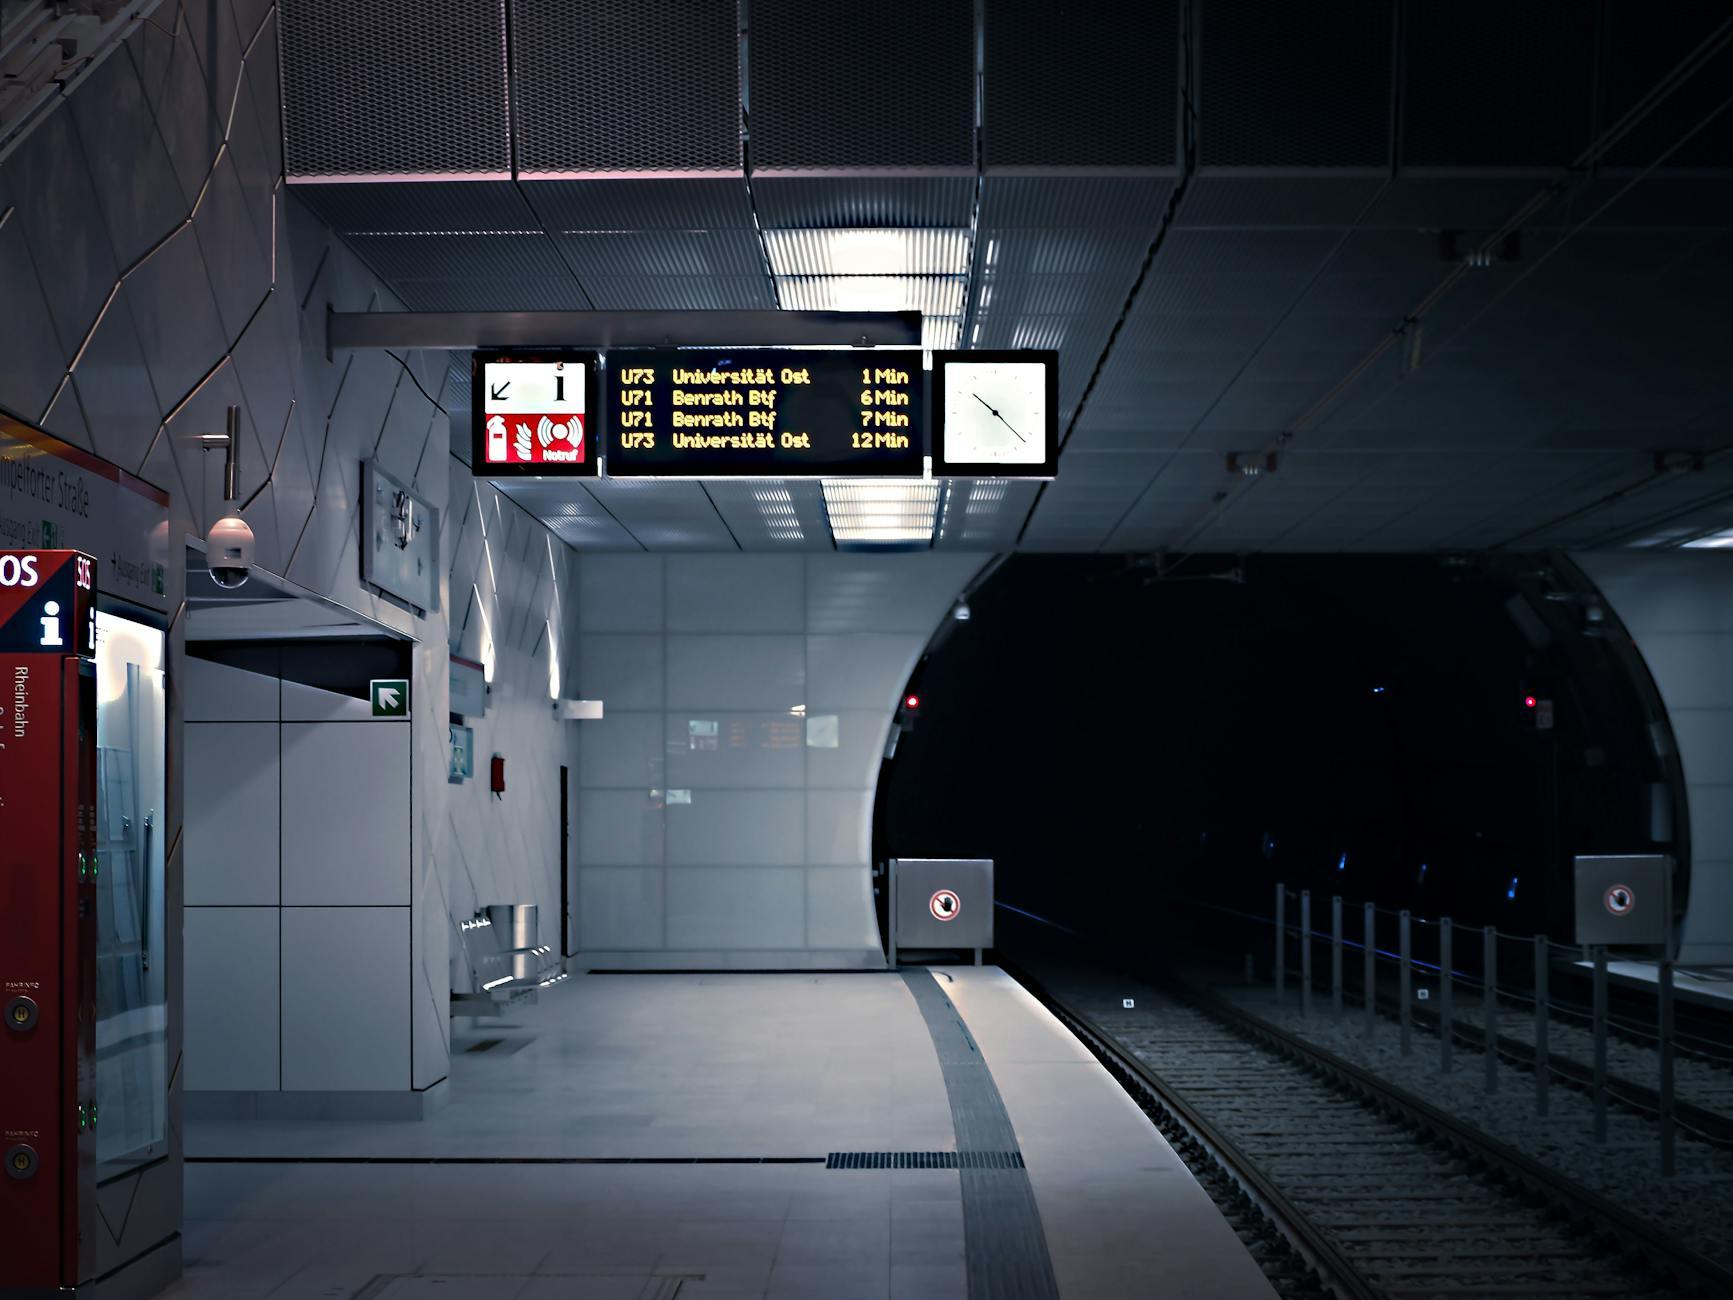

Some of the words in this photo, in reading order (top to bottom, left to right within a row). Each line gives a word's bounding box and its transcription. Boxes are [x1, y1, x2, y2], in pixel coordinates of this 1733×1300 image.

[622, 369, 654, 384] U73
[673, 368, 775, 384] Universität
[781, 369, 810, 384] Ost
[863, 369, 871, 384] 1
[875, 369, 908, 384] Min
[622, 390, 652, 405] U71
[673, 390, 743, 405] Benrath
[749, 390, 776, 409] Btf
[861, 390, 873, 405] 6
[875, 390, 908, 405] Min
[622, 411, 652, 427] U71
[673, 411, 743, 427] Benrath
[749, 411, 776, 430] Btf
[861, 411, 873, 426] 7
[875, 411, 908, 426] Min
[622, 433, 654, 448] U73
[673, 433, 775, 448] Universität
[781, 433, 810, 448] Ost
[852, 433, 873, 448] 12
[875, 433, 908, 448] Min
[58, 472, 89, 518] Straße
[77, 556, 91, 590] SOS
[14, 666, 29, 737] Rheinbahn
